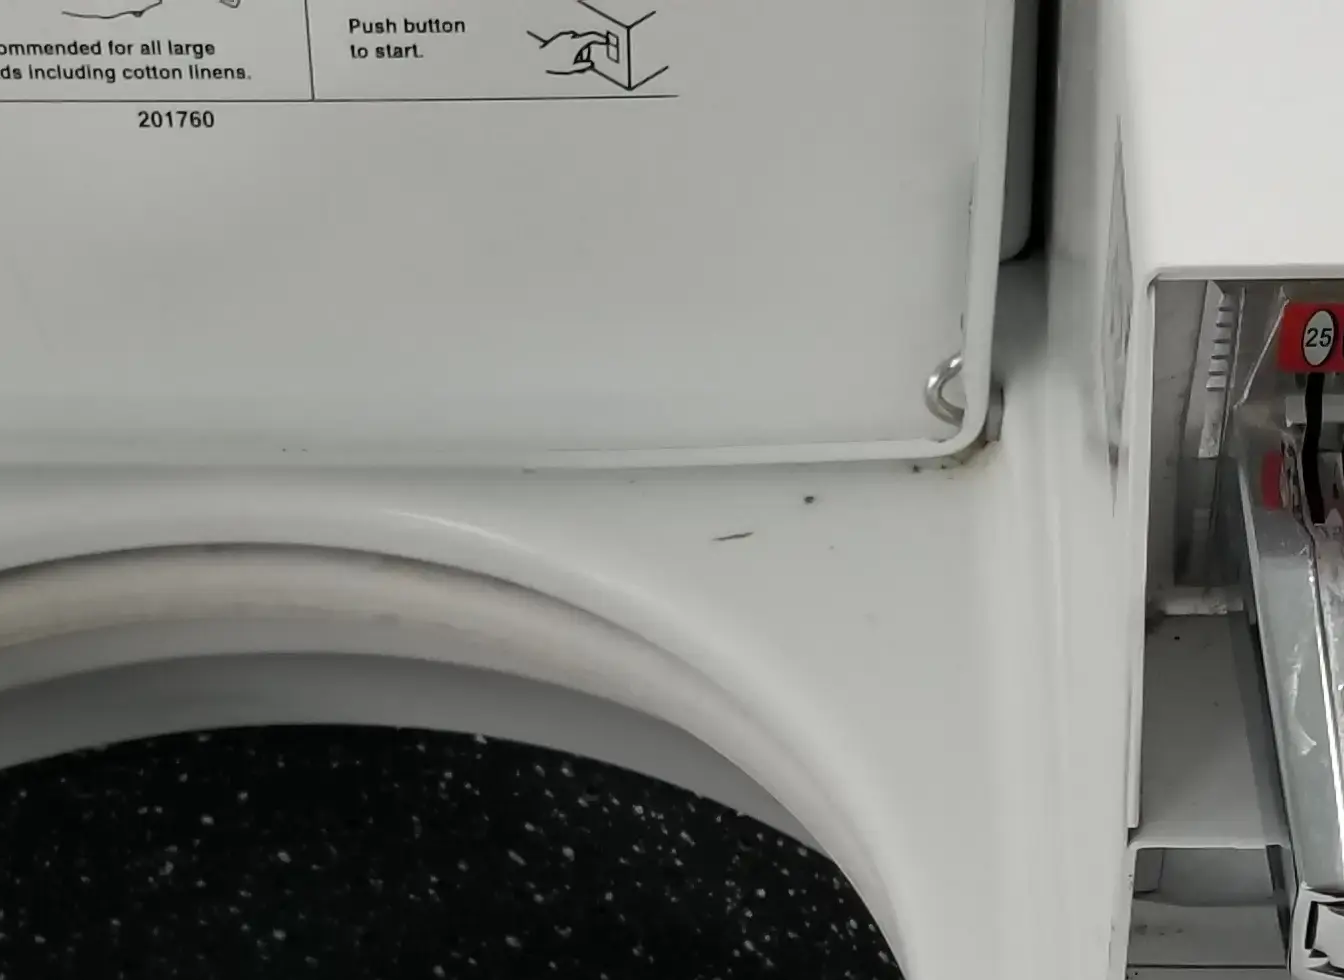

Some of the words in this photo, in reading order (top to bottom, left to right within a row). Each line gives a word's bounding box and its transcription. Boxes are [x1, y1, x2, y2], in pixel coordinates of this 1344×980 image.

[348, 17, 398, 35] Push
[403, 17, 466, 34] button
[107, 39, 134, 56] for
[140, 39, 162, 56] all
[167, 39, 216, 60] large
[349, 43, 369, 60] to
[375, 42, 424, 60] start.
[28, 63, 117, 84] including
[121, 64, 183, 81] cotton
[188, 63, 252, 81] linens.
[137, 109, 215, 129] 201760
[1306, 327, 1333, 348] 25
